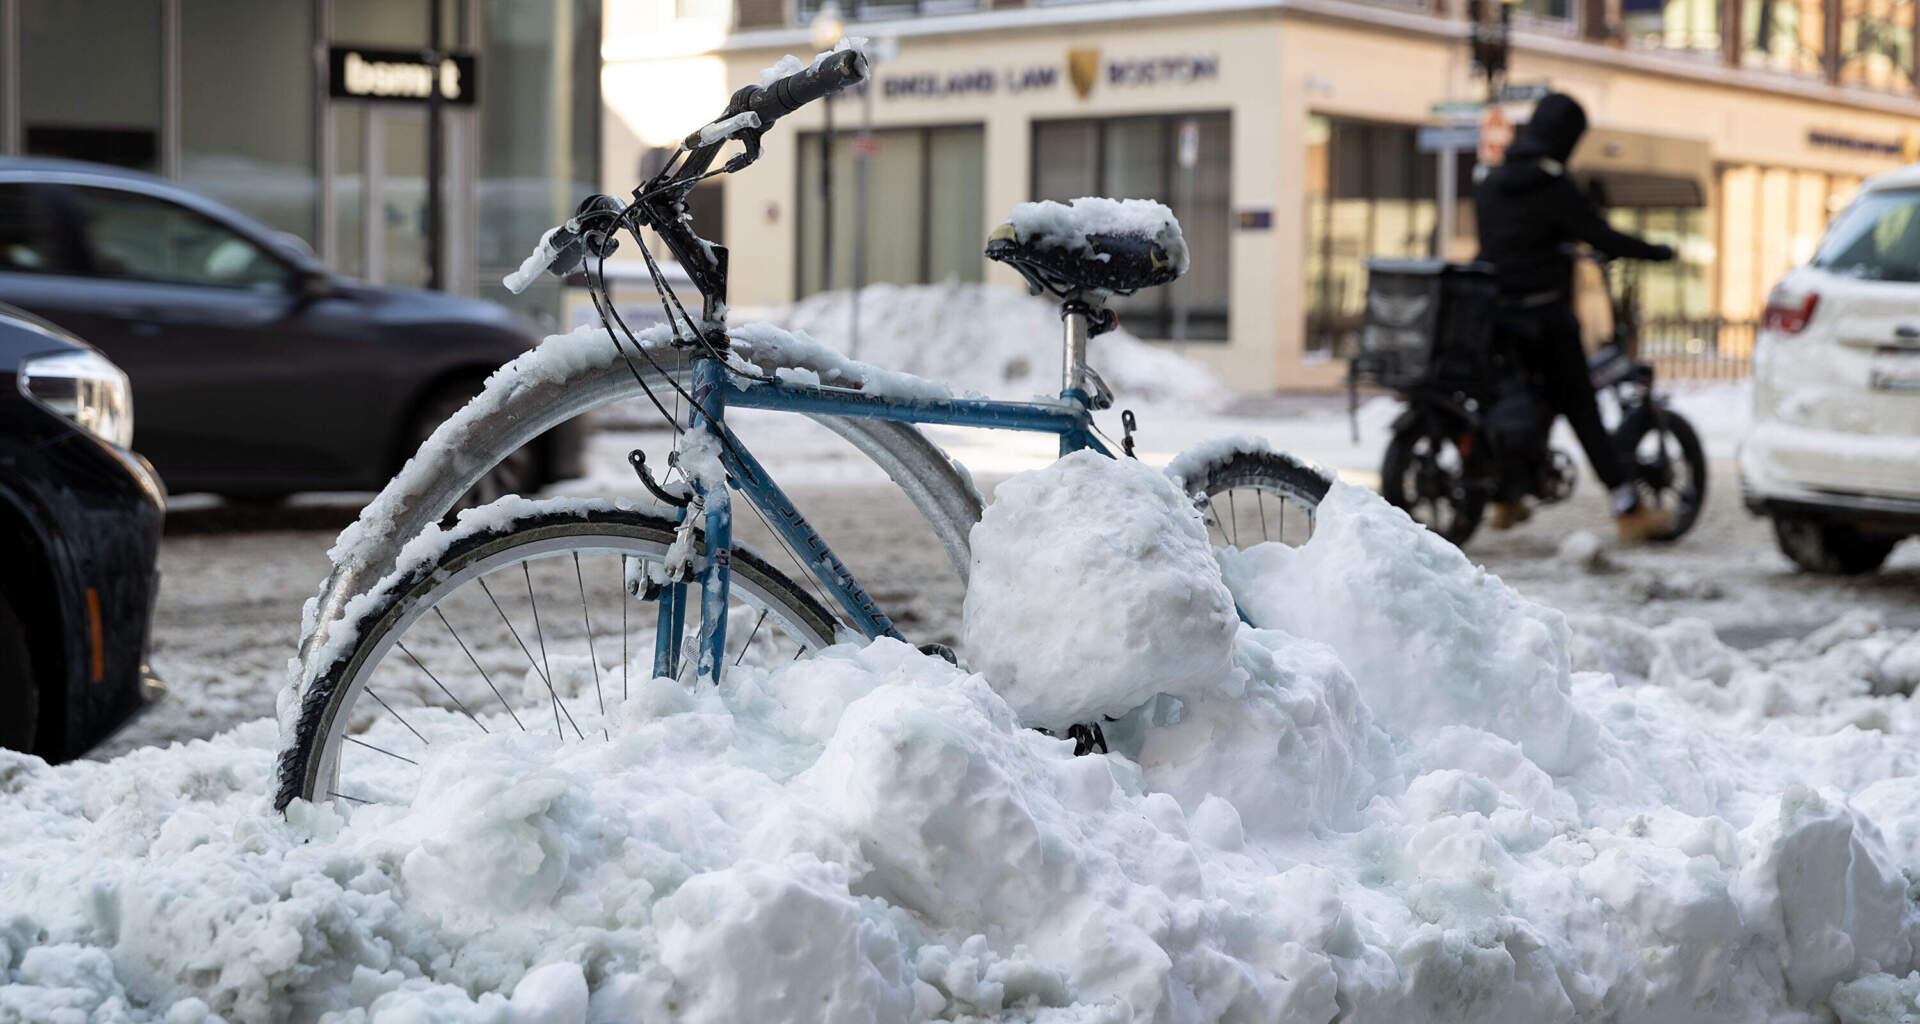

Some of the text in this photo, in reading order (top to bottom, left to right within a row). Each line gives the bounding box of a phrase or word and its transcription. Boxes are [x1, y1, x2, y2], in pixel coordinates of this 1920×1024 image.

[882, 71, 996, 99] ENGLAND
[1005, 65, 1060, 93] LAW
[1106, 53, 1219, 86] BOSTON
[780, 503, 908, 644] SPECIALIZE
